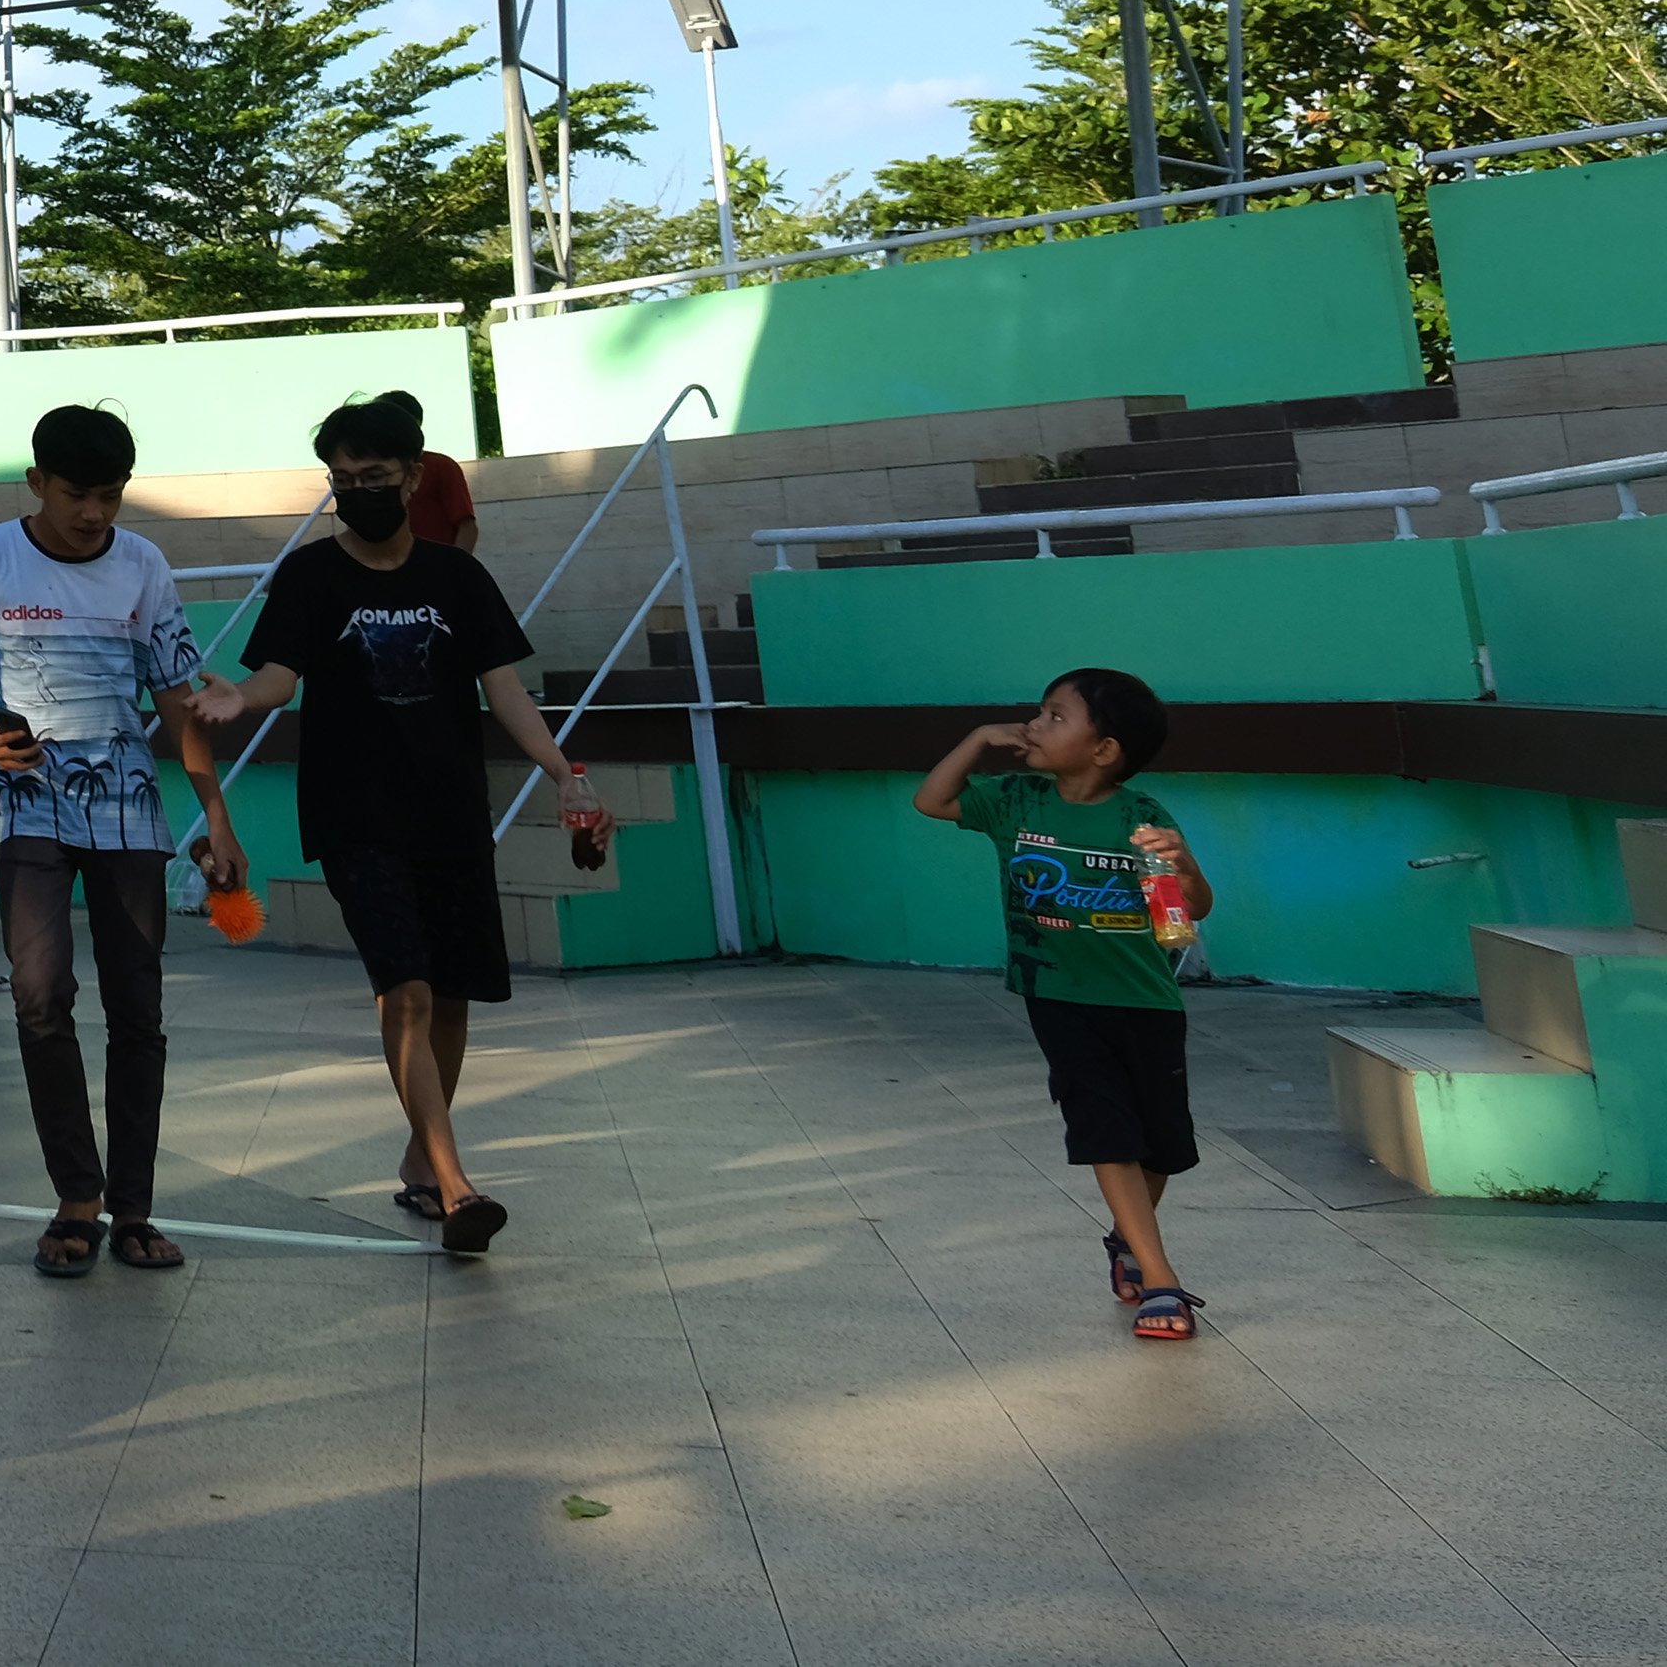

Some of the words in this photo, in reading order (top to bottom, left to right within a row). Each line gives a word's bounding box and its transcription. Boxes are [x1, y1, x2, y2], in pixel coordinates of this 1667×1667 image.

[1, 604, 64, 621] adidas
[336, 604, 453, 642] ROMANCE
[1036, 915, 1070, 928] STREET
